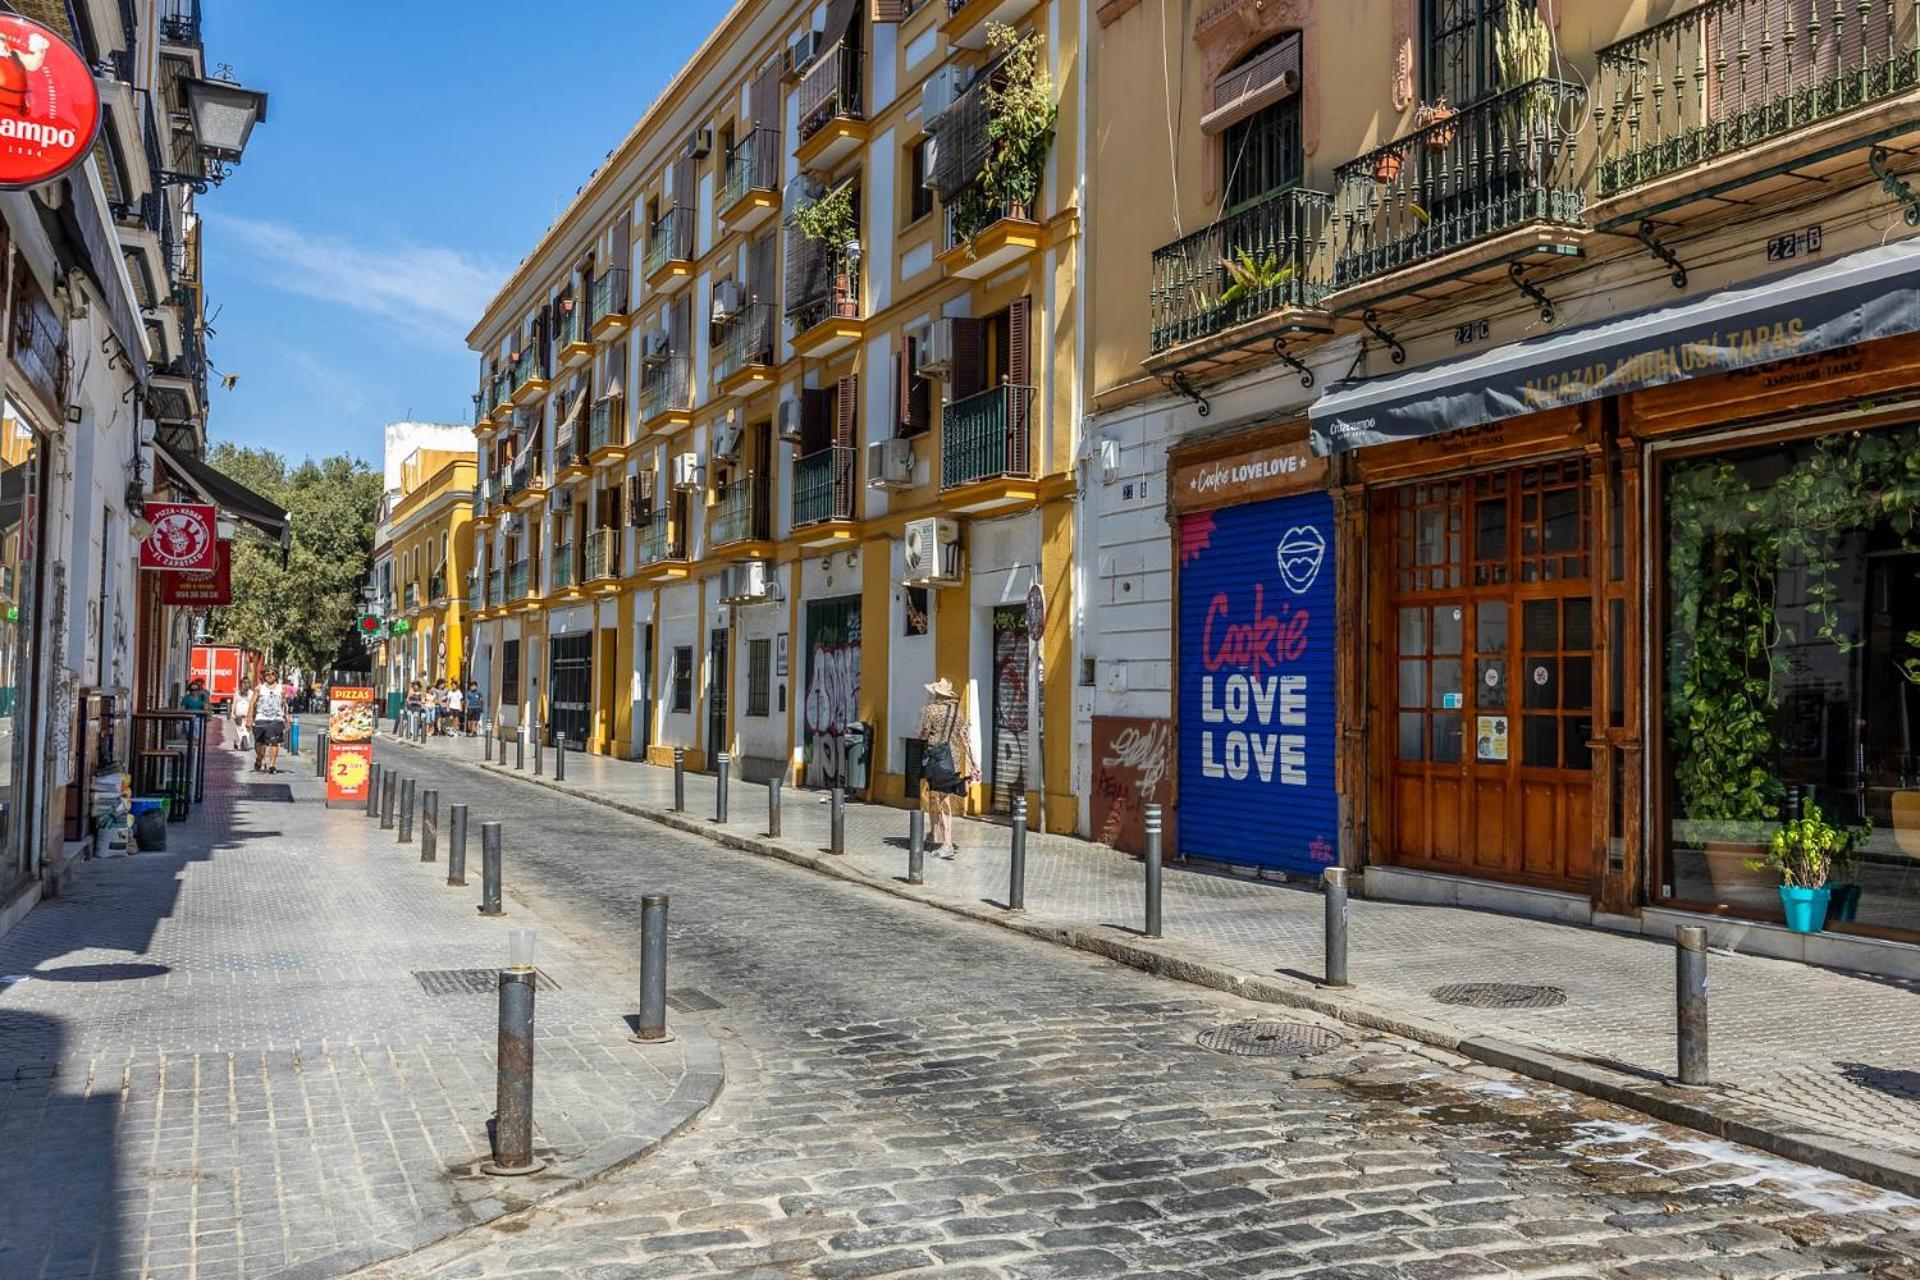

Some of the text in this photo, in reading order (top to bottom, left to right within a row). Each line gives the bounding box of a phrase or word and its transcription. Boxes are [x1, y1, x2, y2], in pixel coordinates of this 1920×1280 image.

[1769, 236, 1795, 260] 22
[1809, 228, 1821, 250] B
[1523, 362, 1608, 406] ALCAZAR
[1615, 332, 1719, 384] ANDALUSÍ
[1726, 318, 1804, 363] TAPAS
[1231, 456, 1297, 483] LOVELOVE
[154, 507, 175, 519] PIZZA
[152, 552, 204, 567] EL ZAPATAZO
[1203, 583, 1310, 684] Cookie
[335, 690, 370, 699] PIZZAS
[1202, 674, 1307, 726] LOVE
[336, 763, 348, 776] 2
[1202, 730, 1307, 786] LOVE
